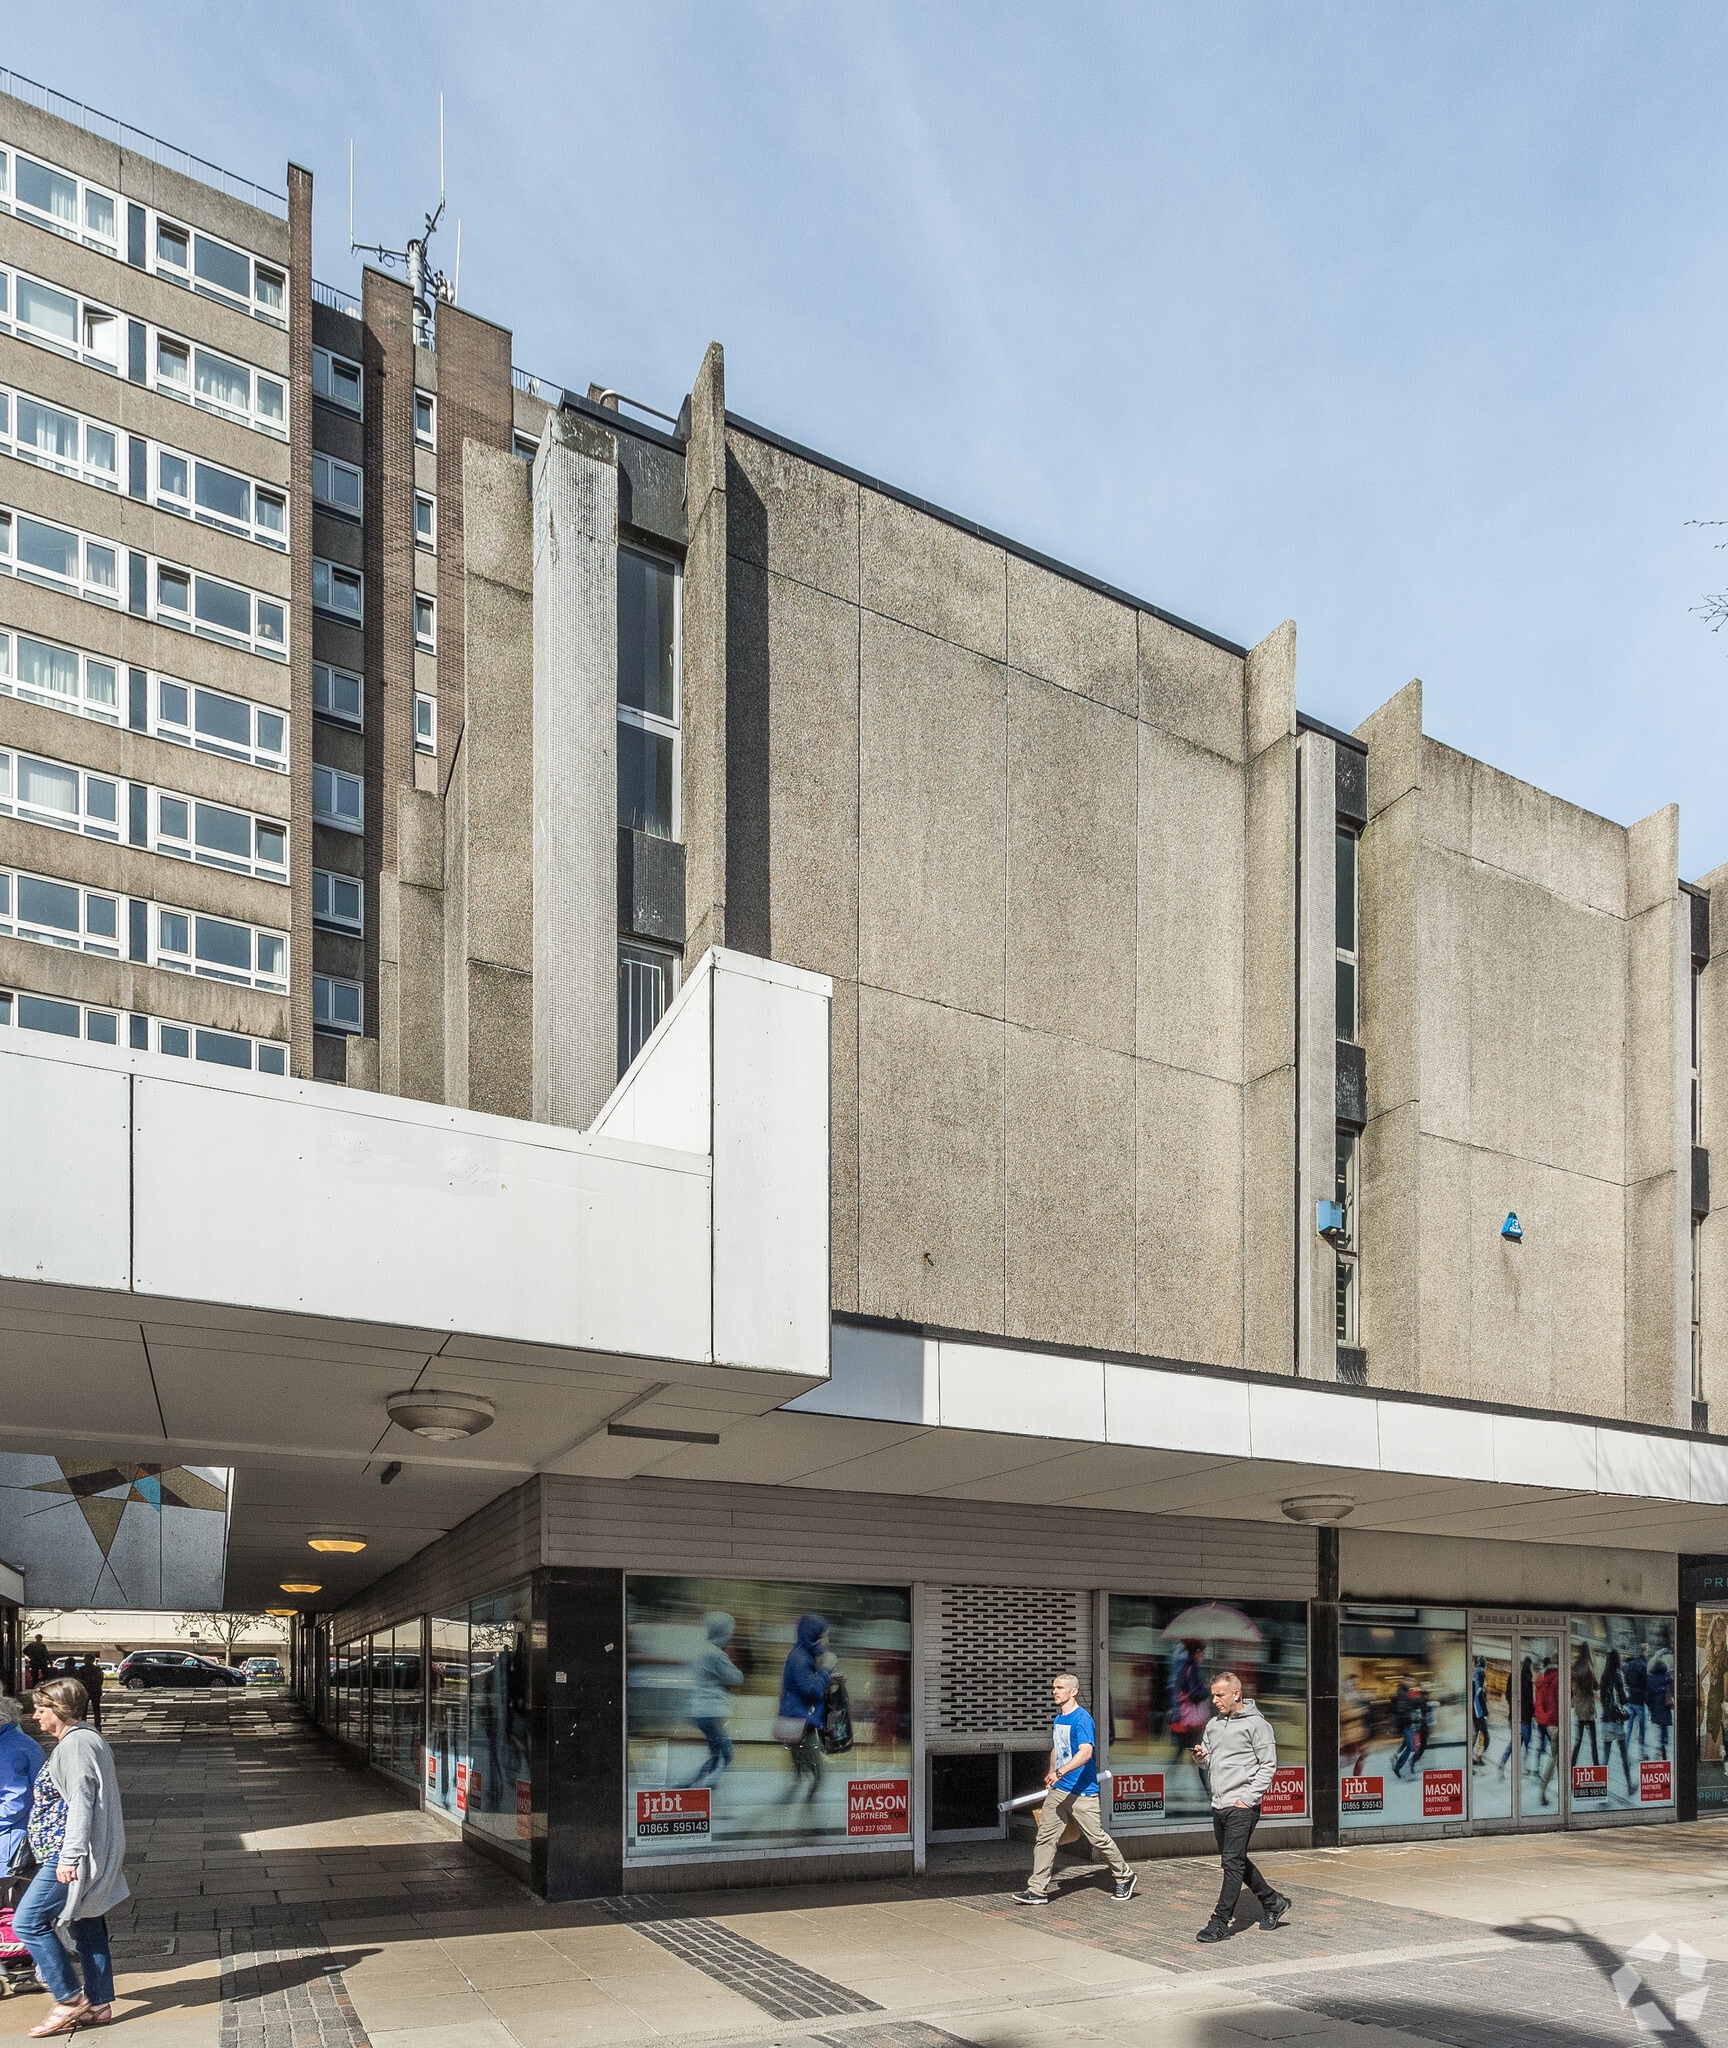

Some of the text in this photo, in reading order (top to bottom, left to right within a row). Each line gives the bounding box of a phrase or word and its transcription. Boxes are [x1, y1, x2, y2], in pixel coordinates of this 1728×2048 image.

[1576, 1768, 1594, 1785] jrbt
[1641, 1772, 1670, 1784] MASON
[1117, 1776, 1145, 1797] jrbt
[1345, 1778, 1367, 1797] jrbt
[1425, 1783, 1460, 1795] MASON
[643, 1793, 682, 1817] jrbt
[851, 1795, 906, 1811] MASON
[1114, 1800, 1163, 1811] 01865 595143
[851, 1812, 889, 1820] PARTNERS
[640, 1821, 708, 1834] 01865 595143
